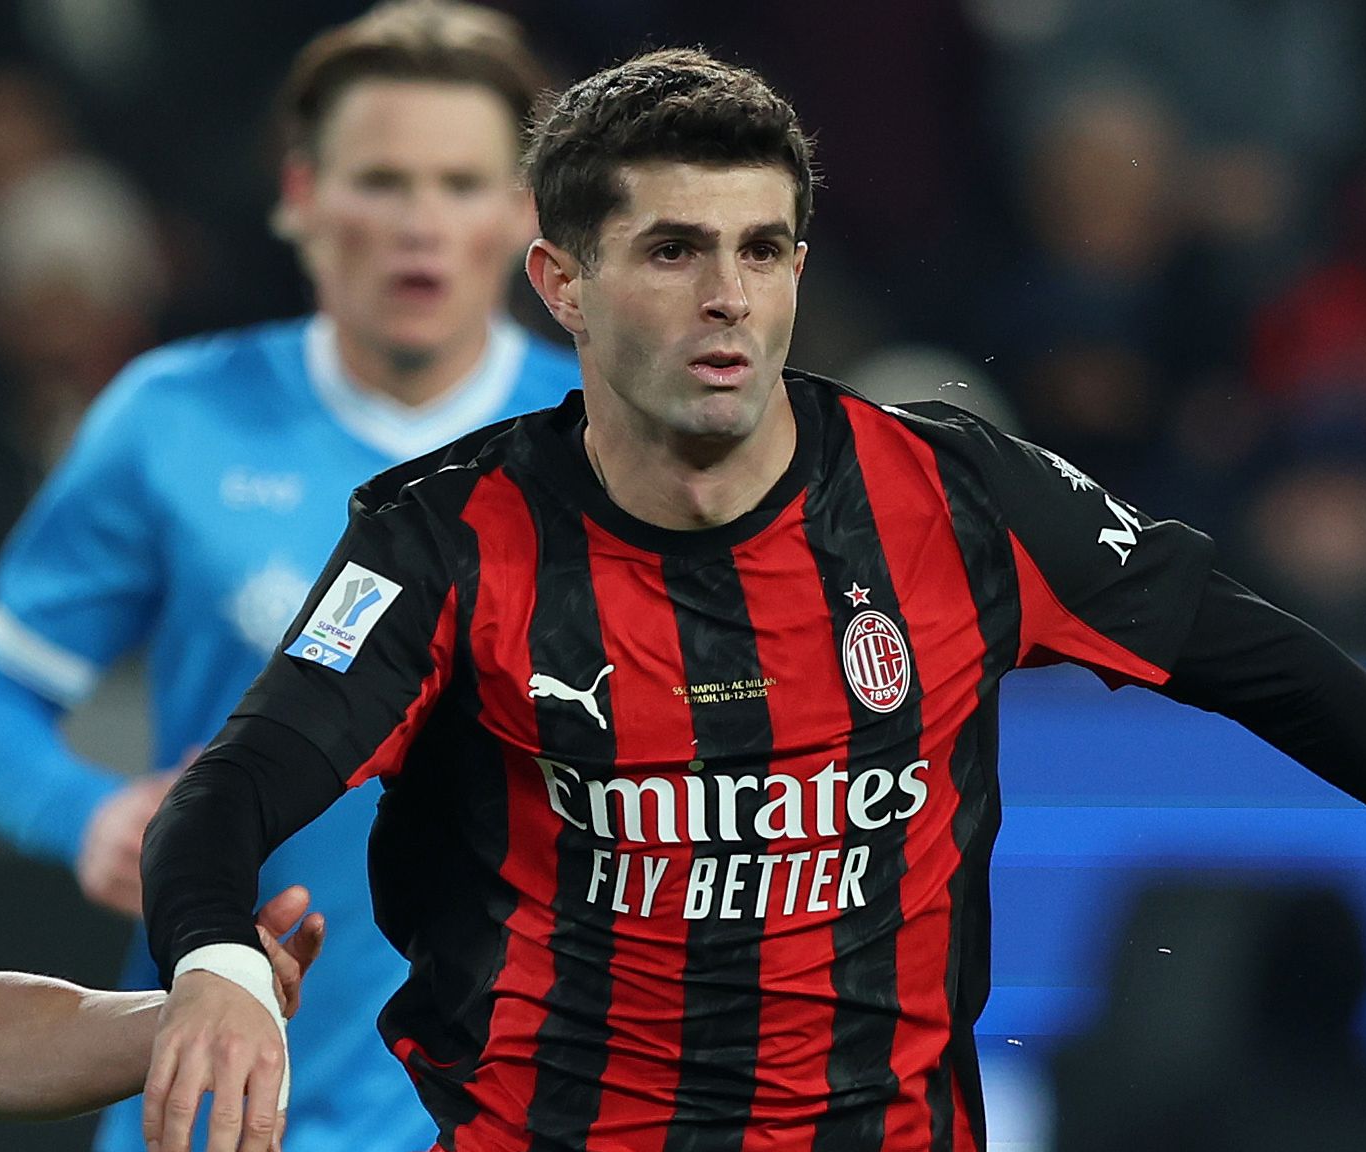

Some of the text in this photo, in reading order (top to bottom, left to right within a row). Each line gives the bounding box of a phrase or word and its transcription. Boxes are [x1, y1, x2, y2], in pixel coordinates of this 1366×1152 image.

[316, 620, 357, 642] SUPERCUP
[853, 619, 888, 642] ACM
[672, 686, 689, 696] SSC
[691, 683, 725, 695] NAPOLI
[732, 680, 744, 690] AC
[745, 678, 777, 688] MILAN
[684, 688, 768, 704] RIYADH, 18-12-2025
[868, 686, 899, 701] 1899
[532, 756, 929, 843] Emirates
[586, 846, 871, 920] FLY BETTER
